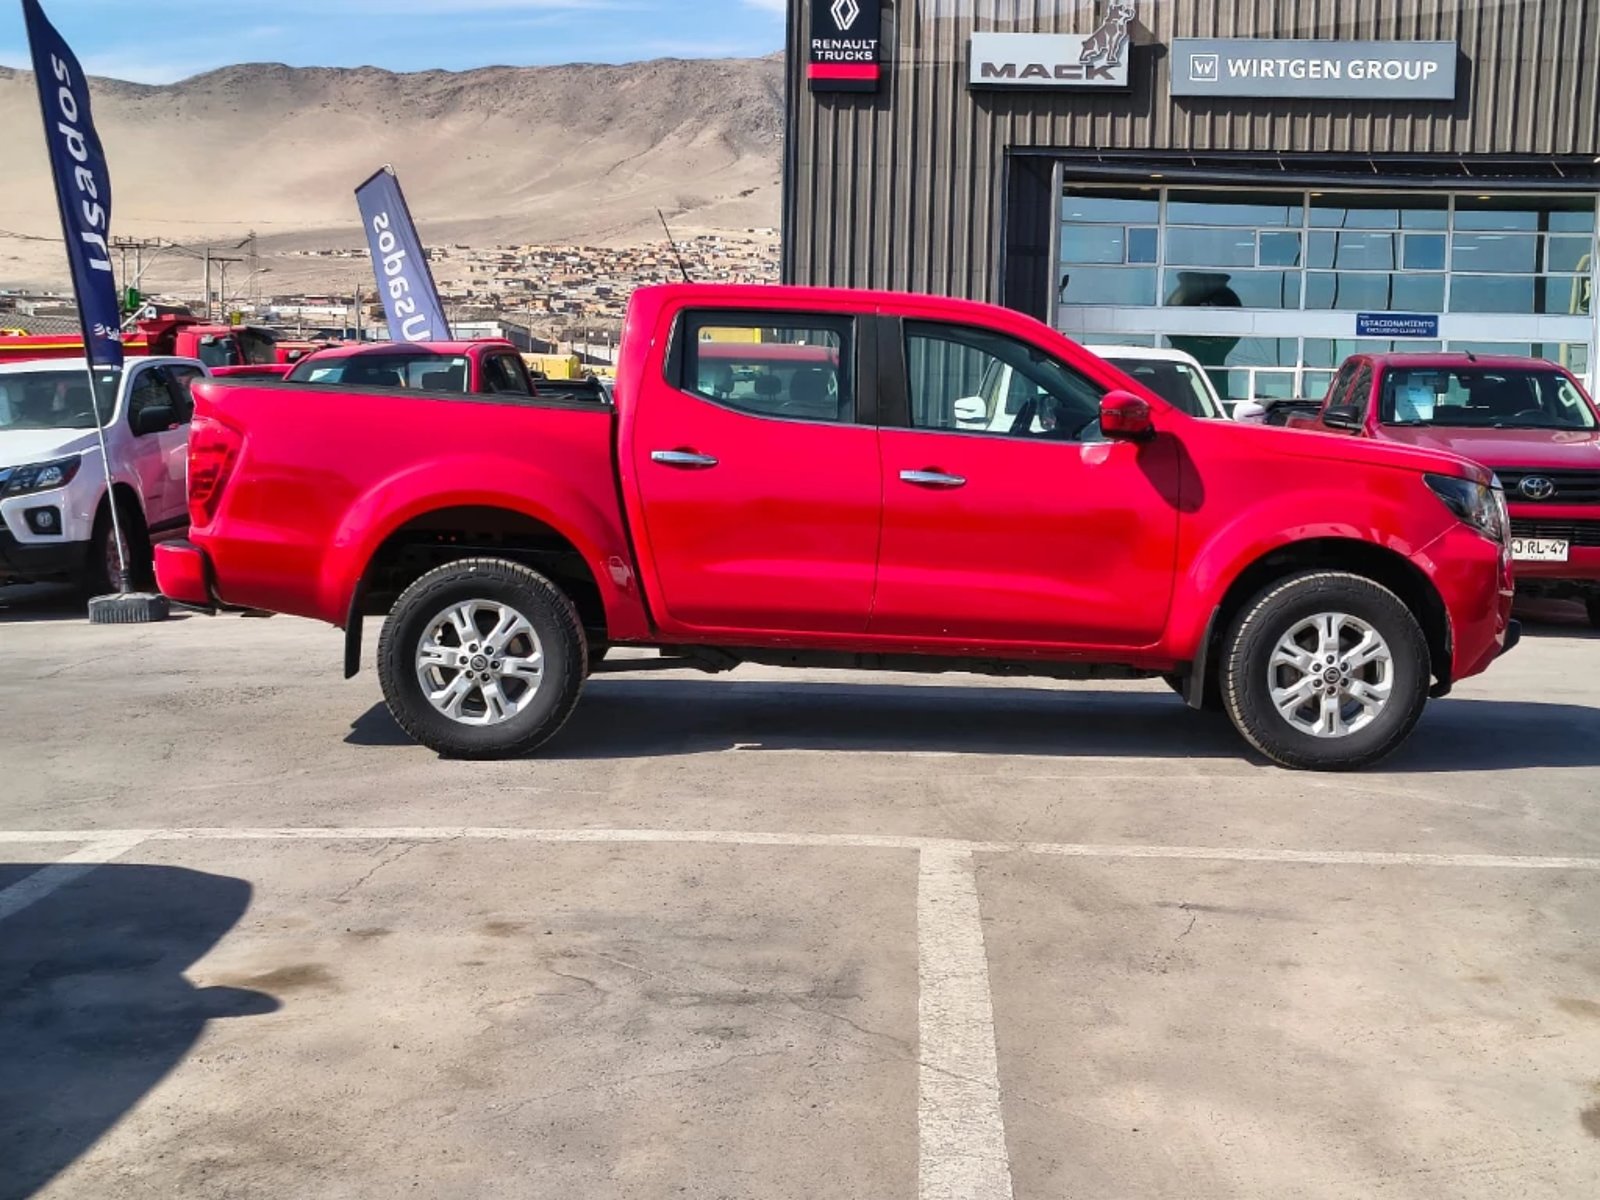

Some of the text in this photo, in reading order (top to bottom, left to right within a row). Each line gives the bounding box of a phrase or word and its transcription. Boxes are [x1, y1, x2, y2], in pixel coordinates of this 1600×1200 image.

[812, 39, 877, 49] RENAULT
[815, 51, 873, 60] TRUCKS
[981, 62, 1117, 80] MACK
[1227, 59, 1438, 80] WIRTGEN GROUP
[51, 53, 112, 272] Usados
[1360, 320, 1435, 328] ESTACIONAMIENTO
